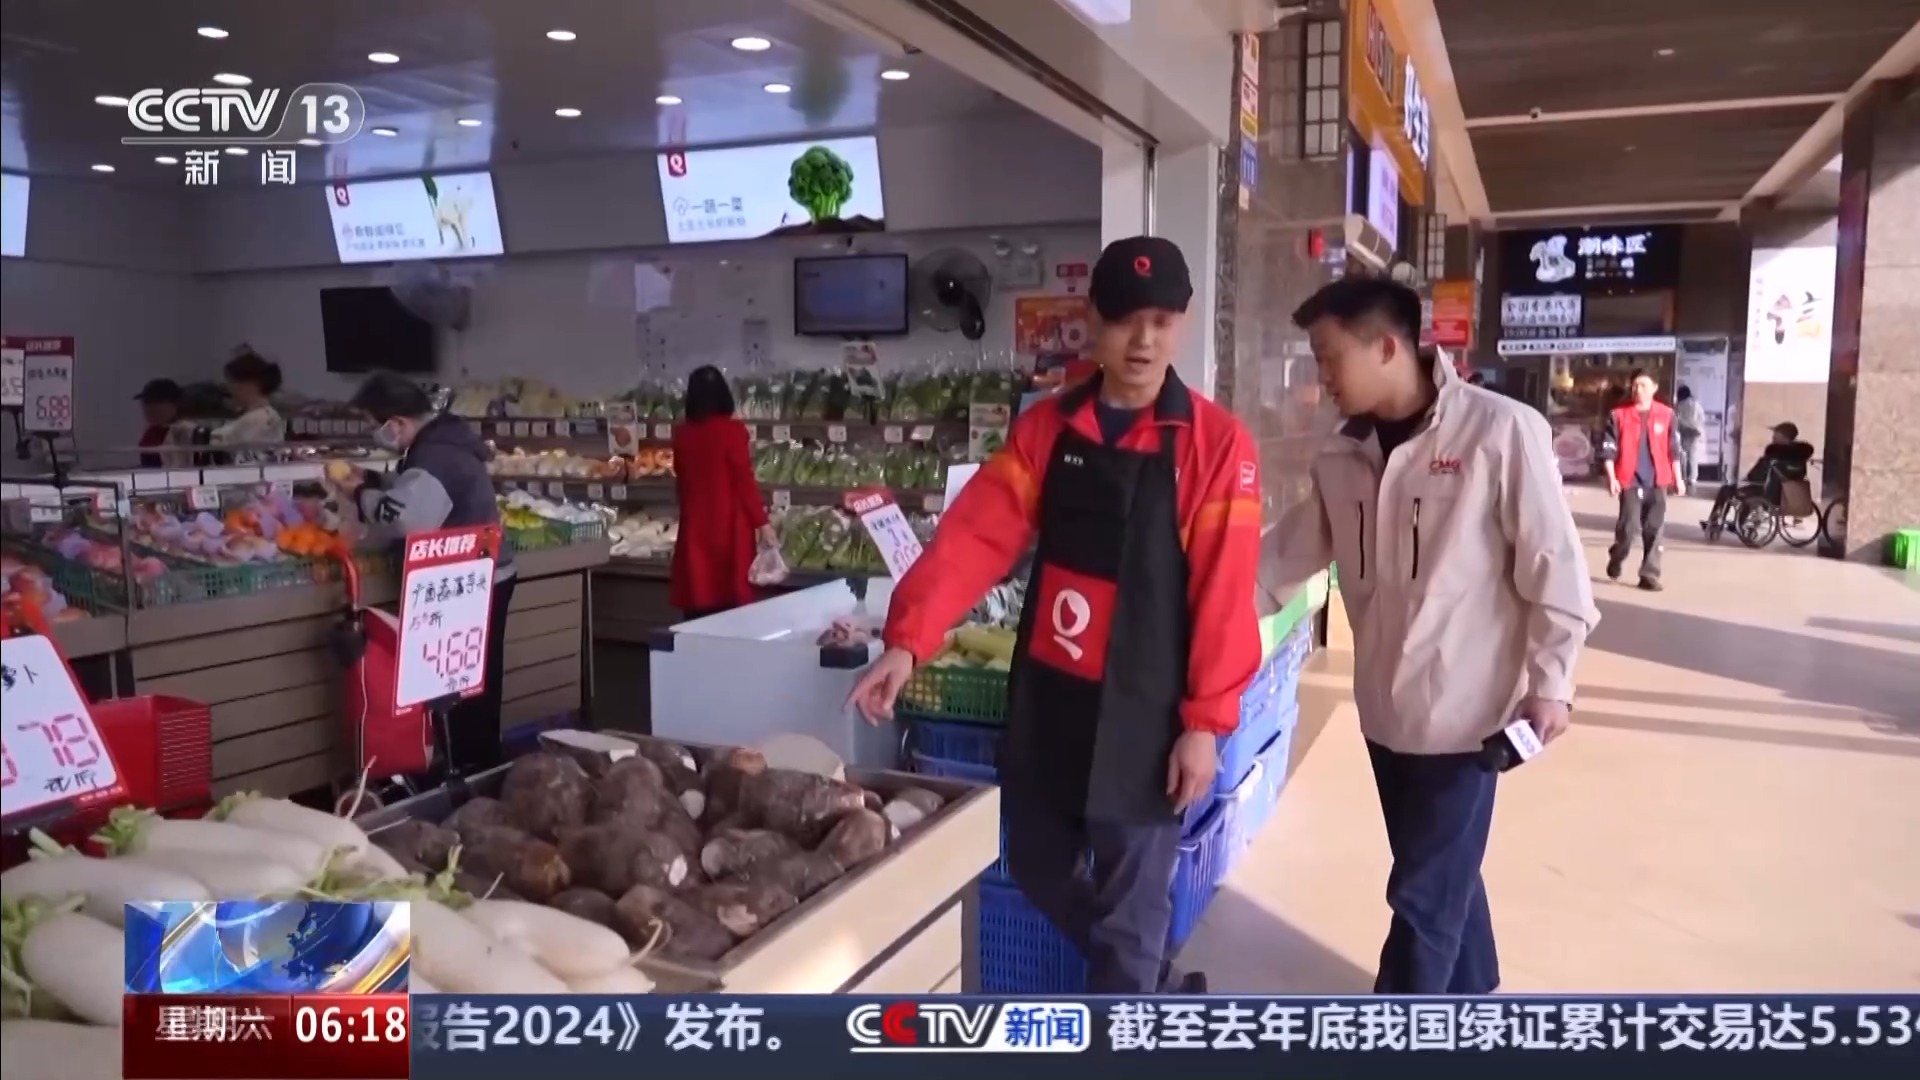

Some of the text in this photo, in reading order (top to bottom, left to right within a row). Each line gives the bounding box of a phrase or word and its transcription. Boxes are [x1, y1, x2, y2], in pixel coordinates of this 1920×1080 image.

[409, 533, 477, 562] 店长推荐
[422, 626, 482, 680] 4.68
